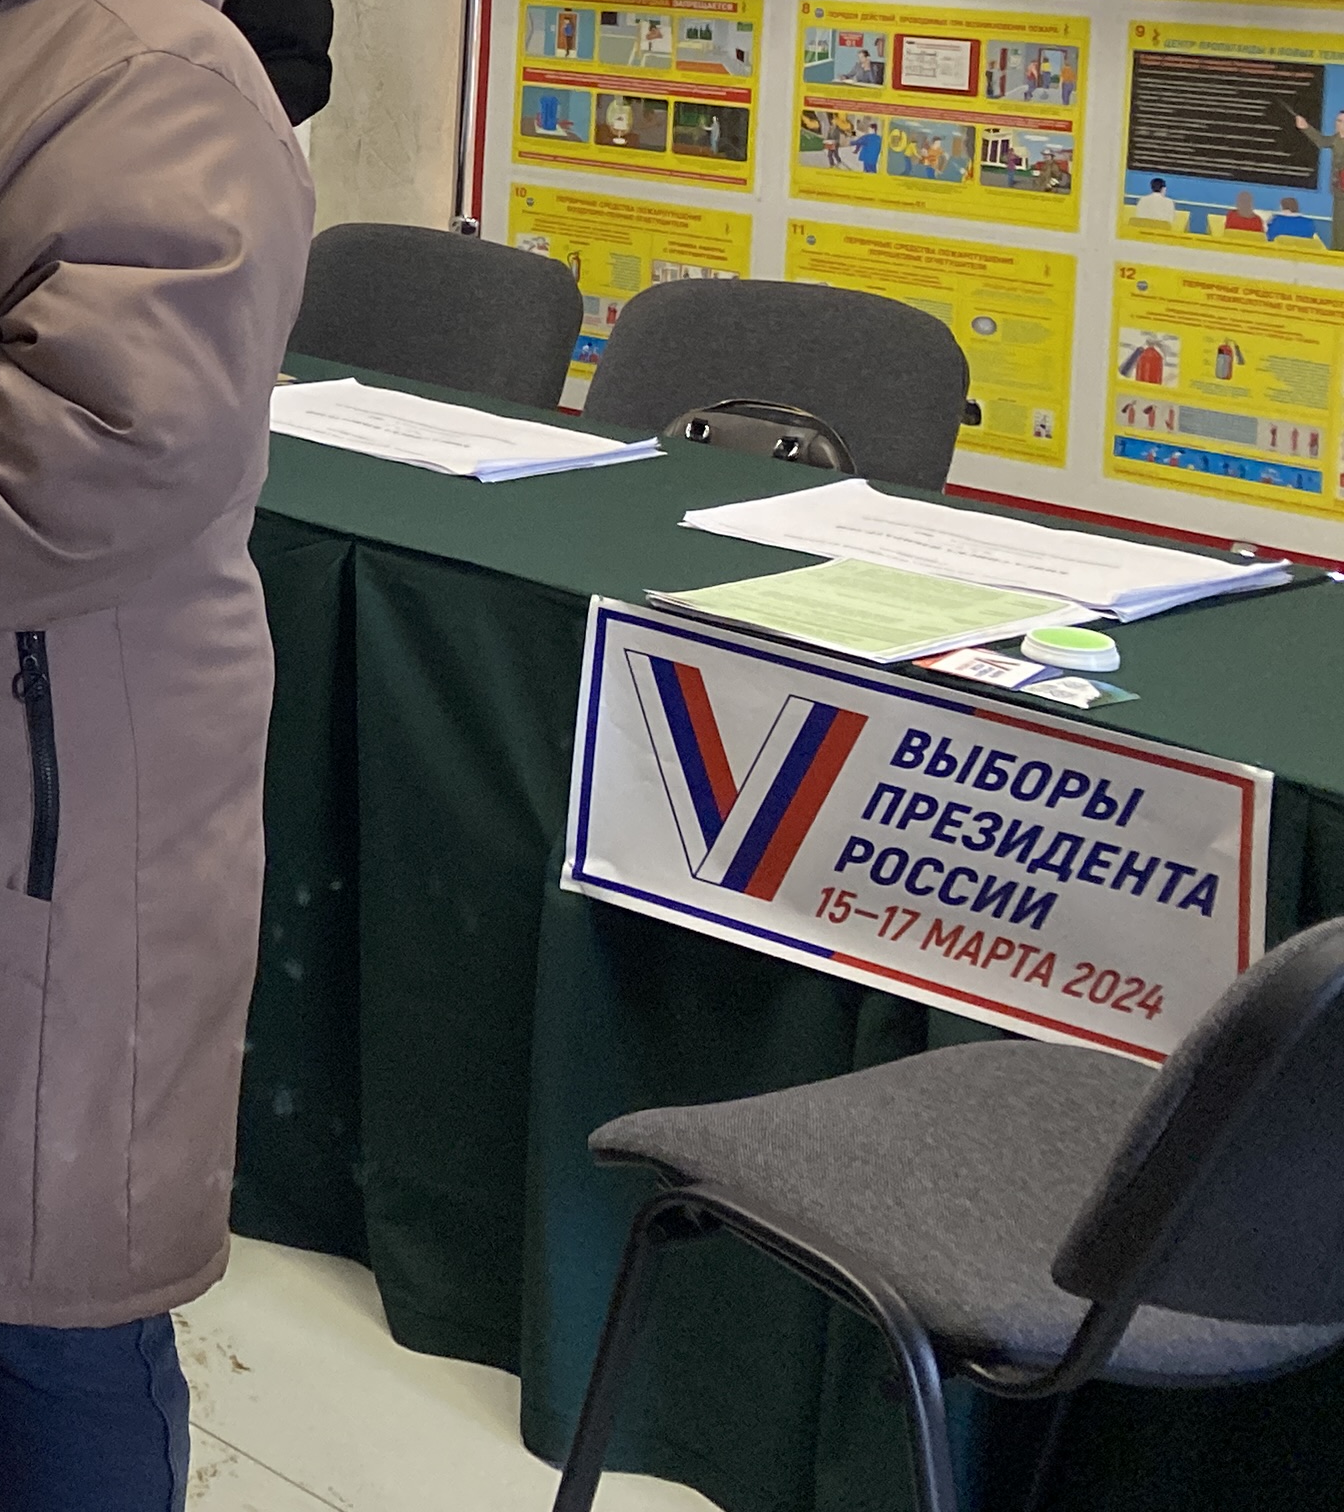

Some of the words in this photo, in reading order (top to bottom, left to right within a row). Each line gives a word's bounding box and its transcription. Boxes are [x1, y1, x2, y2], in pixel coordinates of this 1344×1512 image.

[802, 3, 810, 14] 8
[1135, 25, 1145, 37] 9
[515, 187, 527, 198] 10
[792, 224, 805, 235] 11
[1119, 267, 1136, 280] 12
[889, 728, 1145, 828] ВЫБОРЫ
[861, 782, 1220, 918] ПРЕЗИДЕНТА
[834, 835, 1060, 931] РОССИИ
[920, 918, 1058, 989] МАРТА
[1062, 962, 1164, 1021] 2024
